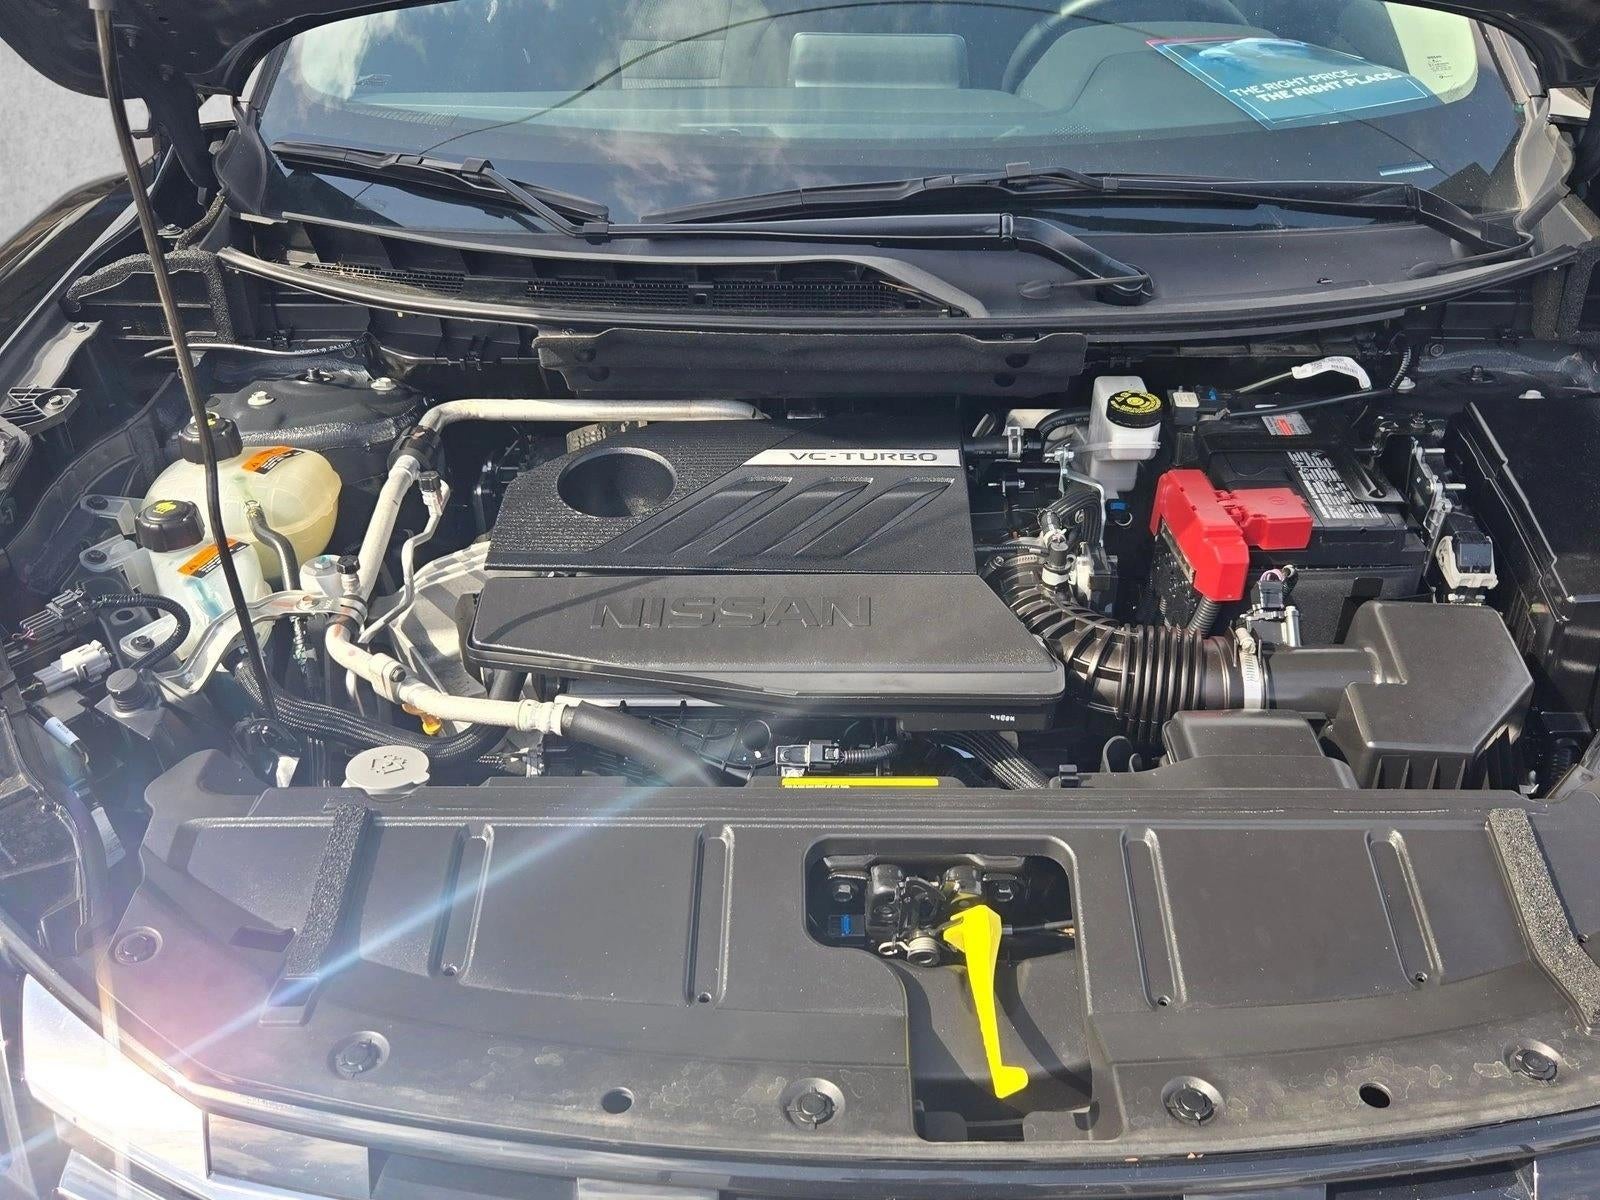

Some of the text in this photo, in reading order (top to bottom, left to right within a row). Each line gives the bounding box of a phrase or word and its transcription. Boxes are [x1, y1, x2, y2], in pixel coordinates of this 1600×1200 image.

[1229, 84, 1266, 98] THE
[1261, 76, 1309, 92] RIGHT
[1255, 90, 1295, 102] THE
[1294, 80, 1344, 97] RIGHT
[789, 452, 938, 462] VC-TURBO
[590, 597, 872, 629] NISSAN
